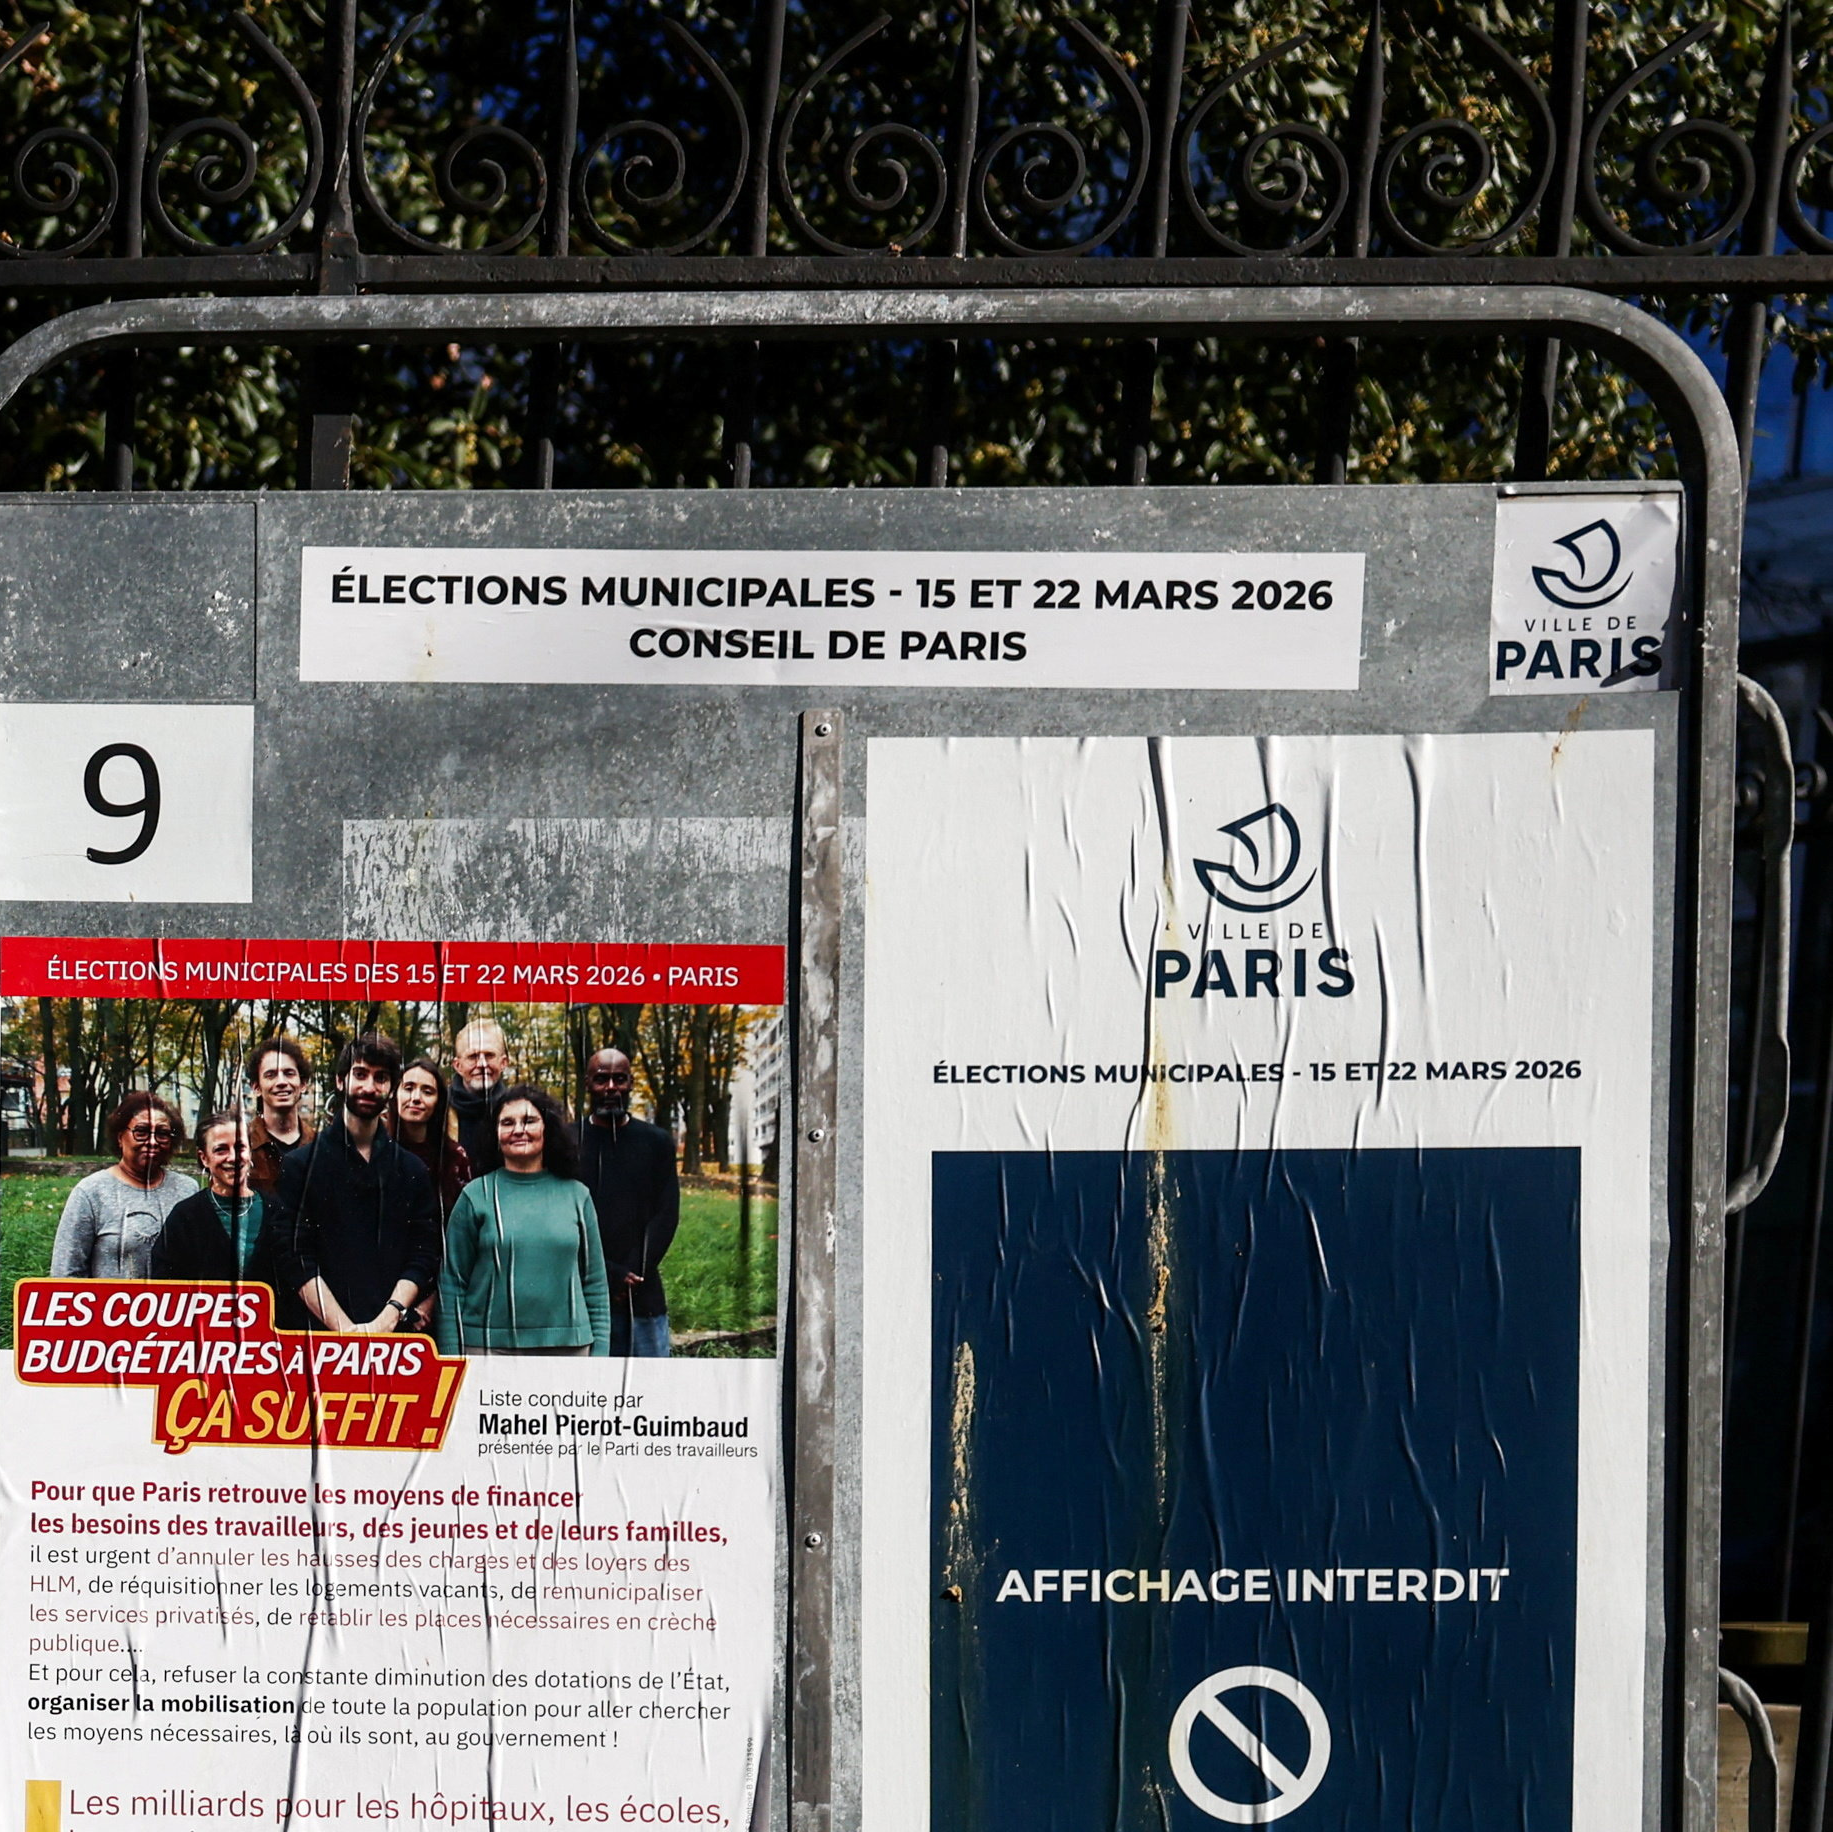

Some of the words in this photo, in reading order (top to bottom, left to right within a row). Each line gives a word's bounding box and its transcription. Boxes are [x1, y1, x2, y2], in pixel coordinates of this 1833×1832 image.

[332, 566, 567, 605] ÉLECTIONS
[582, 577, 874, 607] MUNICIPALES
[917, 579, 955, 608] 15
[971, 580, 1021, 608] ET
[1034, 580, 1080, 608] 22
[1096, 580, 1218, 610] MARS
[1232, 581, 1332, 610] 2026
[1525, 617, 1591, 632] VILLE
[1608, 616, 1636, 630] DE
[630, 628, 814, 659] CONSEIL
[829, 631, 885, 659] DE
[901, 631, 1026, 661] PARIS
[1497, 636, 1663, 682] PARIS
[84, 744, 160, 864] 9
[1188, 922, 1269, 939] VILLE
[1289, 922, 1323, 938] DE
[47, 954, 178, 980] ÉLECTIONS
[185, 962, 348, 983] MUNICIPALES
[354, 963, 399, 983] DES
[406, 964, 436, 983] 15
[443, 964, 470, 984] ET
[477, 965, 505, 984] 22
[513, 965, 579, 985] MARS
[586, 965, 646, 986] 2026
[668, 966, 739, 987] PARIS
[1155, 947, 1355, 998] PARIS
[21, 1291, 96, 1327] LES
[101, 1291, 260, 1328] COUPES
[21, 1333, 281, 1375] BUDGÉTAIRES
[314, 1342, 425, 1376] PARIS
[165, 1379, 232, 1450] ÇA
[243, 1391, 420, 1442] SUFFIT
[421, 1366, 458, 1443] !
[479, 1414, 547, 1435] Mahel
[556, 1415, 748, 1438] Pierot-Guimbaud
[995, 1568, 1271, 1602] AFFICHAGE
[1287, 1568, 1510, 1602] INTERDIT
[70, 1789, 120, 1815] Les
[132, 1789, 264, 1817] milliards
[276, 1797, 346, 1824] pour
[357, 1792, 399, 1819] les
[411, 1792, 554, 1826] hôpitaux,
[567, 1795, 609, 1822] les
[620, 1794, 729, 1828] écoles,
